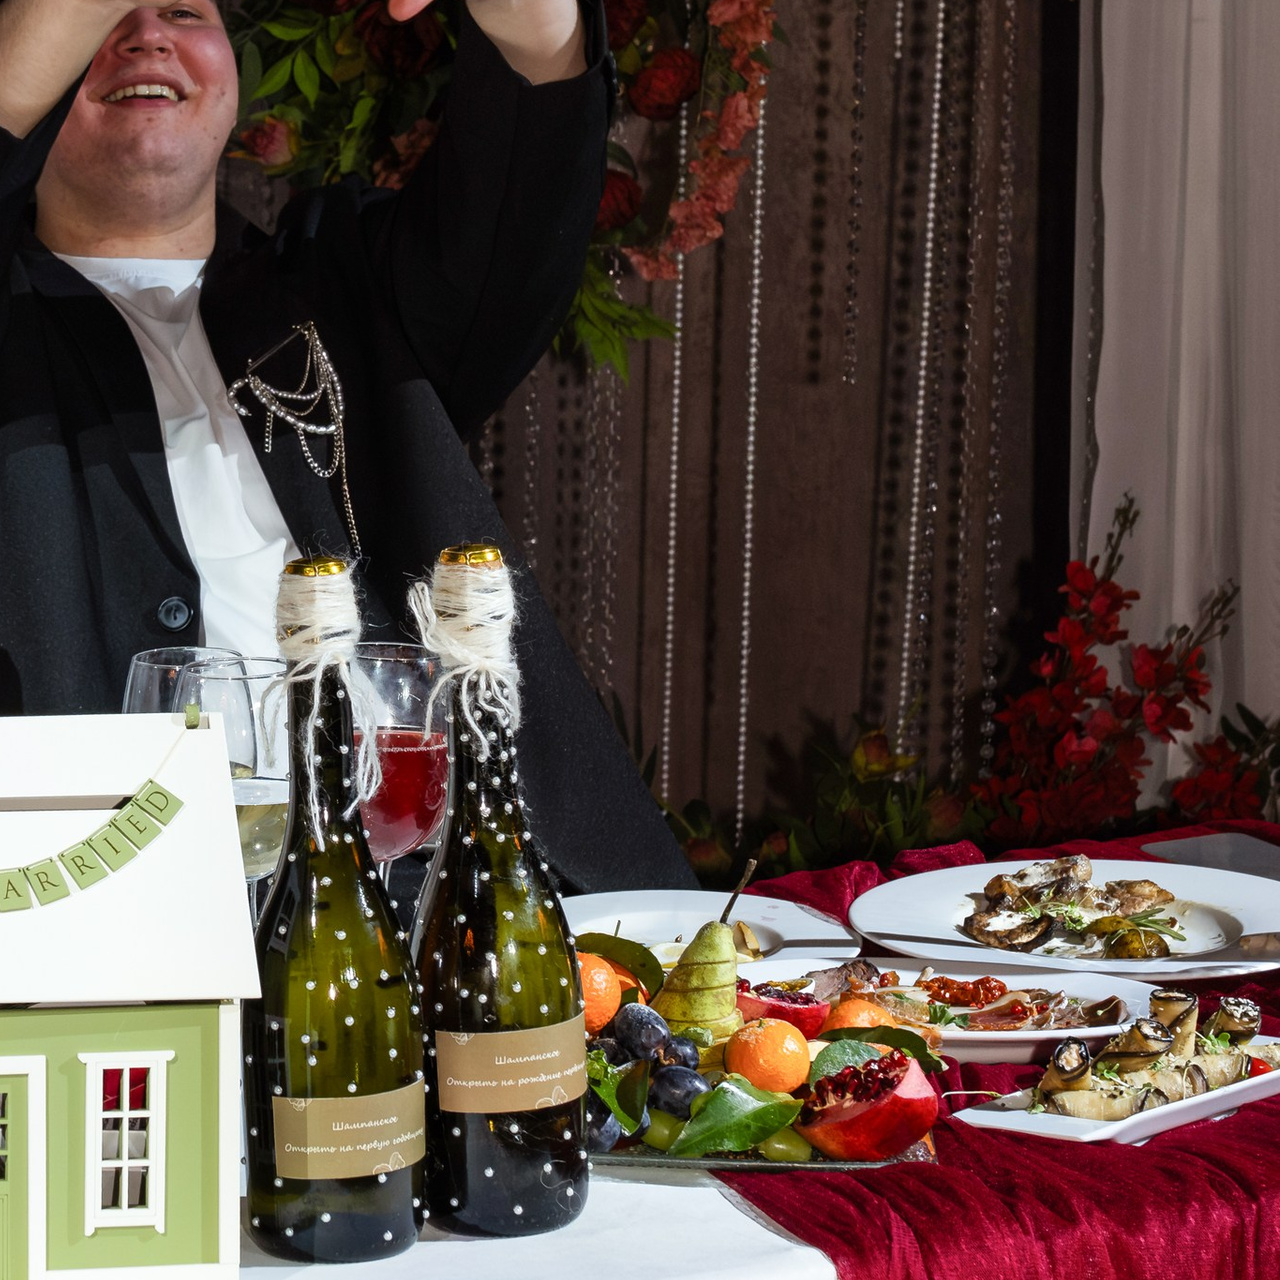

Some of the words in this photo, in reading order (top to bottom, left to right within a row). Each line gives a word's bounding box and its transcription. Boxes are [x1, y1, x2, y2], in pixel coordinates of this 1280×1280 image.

[494, 1049, 561, 1065] Шампанское
[446, 1076, 499, 1089] Открыть
[501, 1077, 516, 1087] на
[518, 1071, 563, 1087] рождение
[332, 1115, 399, 1131] Шампанское
[284, 1143, 337, 1156] Открыть
[339, 1144, 354, 1153] на
[356, 1139, 391, 1153] первую
